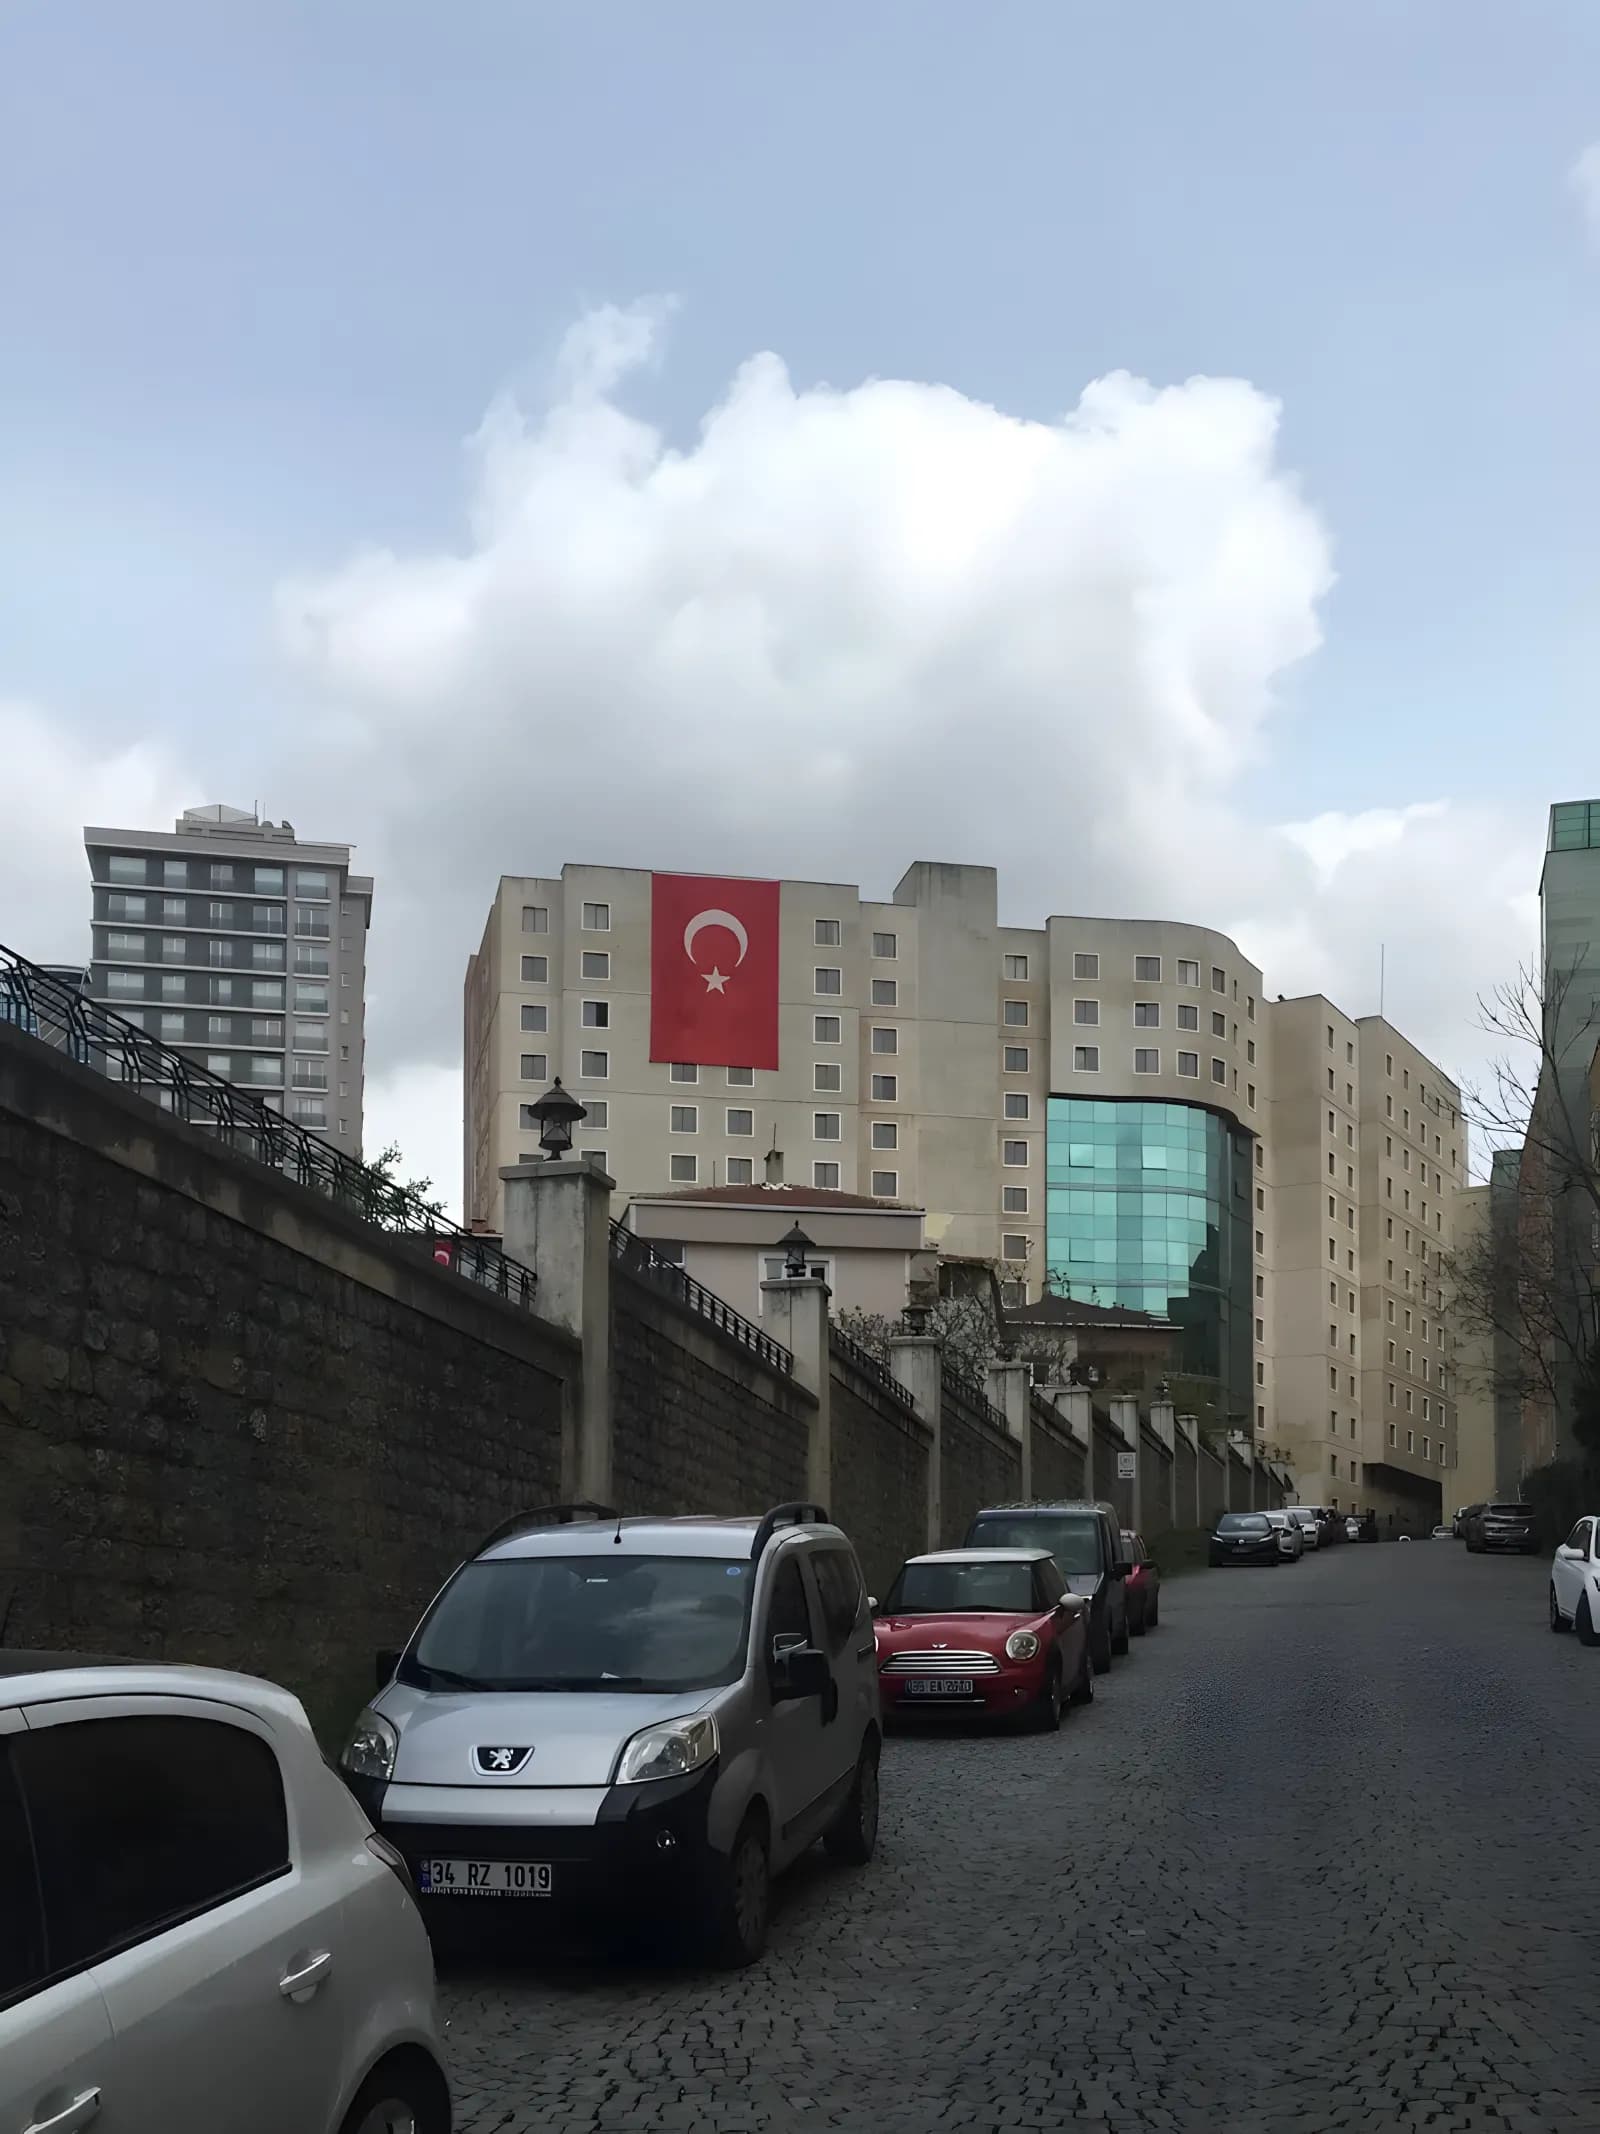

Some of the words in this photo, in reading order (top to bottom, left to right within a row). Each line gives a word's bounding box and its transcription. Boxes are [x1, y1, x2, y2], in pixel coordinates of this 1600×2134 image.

[432, 1862, 455, 1885] 34
[468, 1863, 491, 1886] RZ
[505, 1865, 550, 1888] 1019
